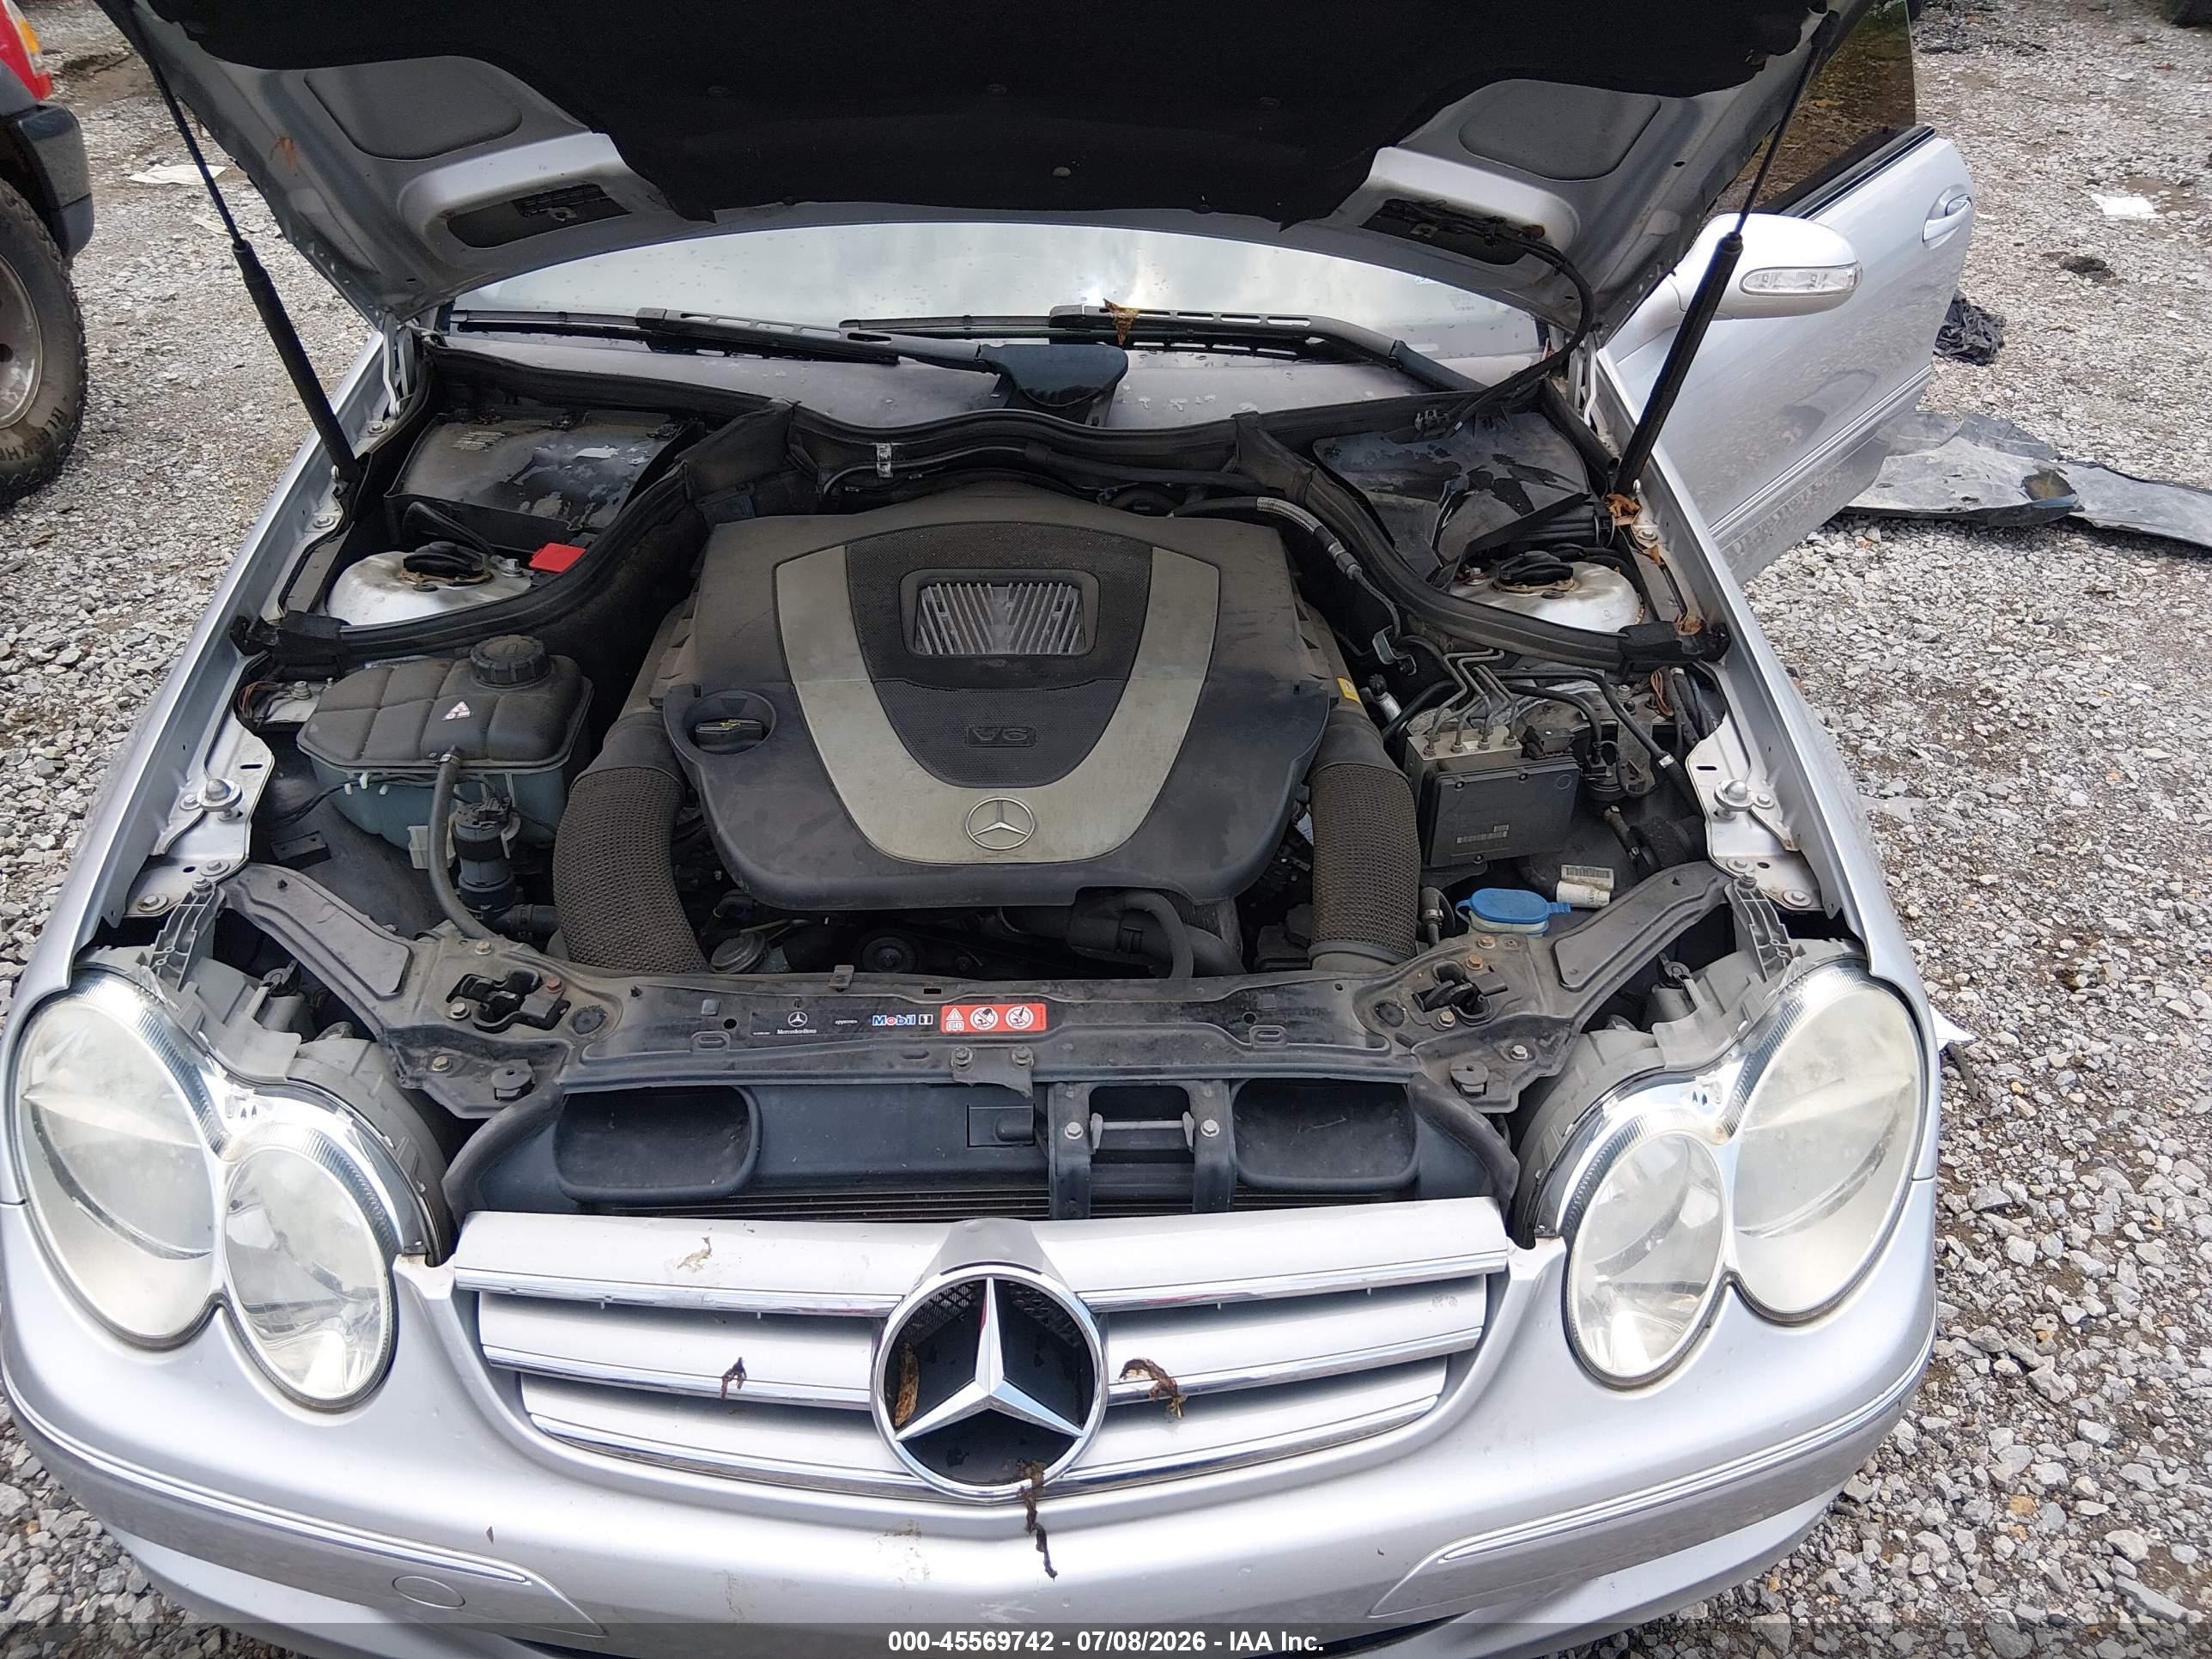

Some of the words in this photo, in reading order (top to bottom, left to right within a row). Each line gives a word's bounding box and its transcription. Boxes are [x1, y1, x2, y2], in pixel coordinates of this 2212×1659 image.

[969, 726, 1029, 743] V6
[872, 1014, 916, 1026] Mobil
[919, 1014, 933, 1025] 1
